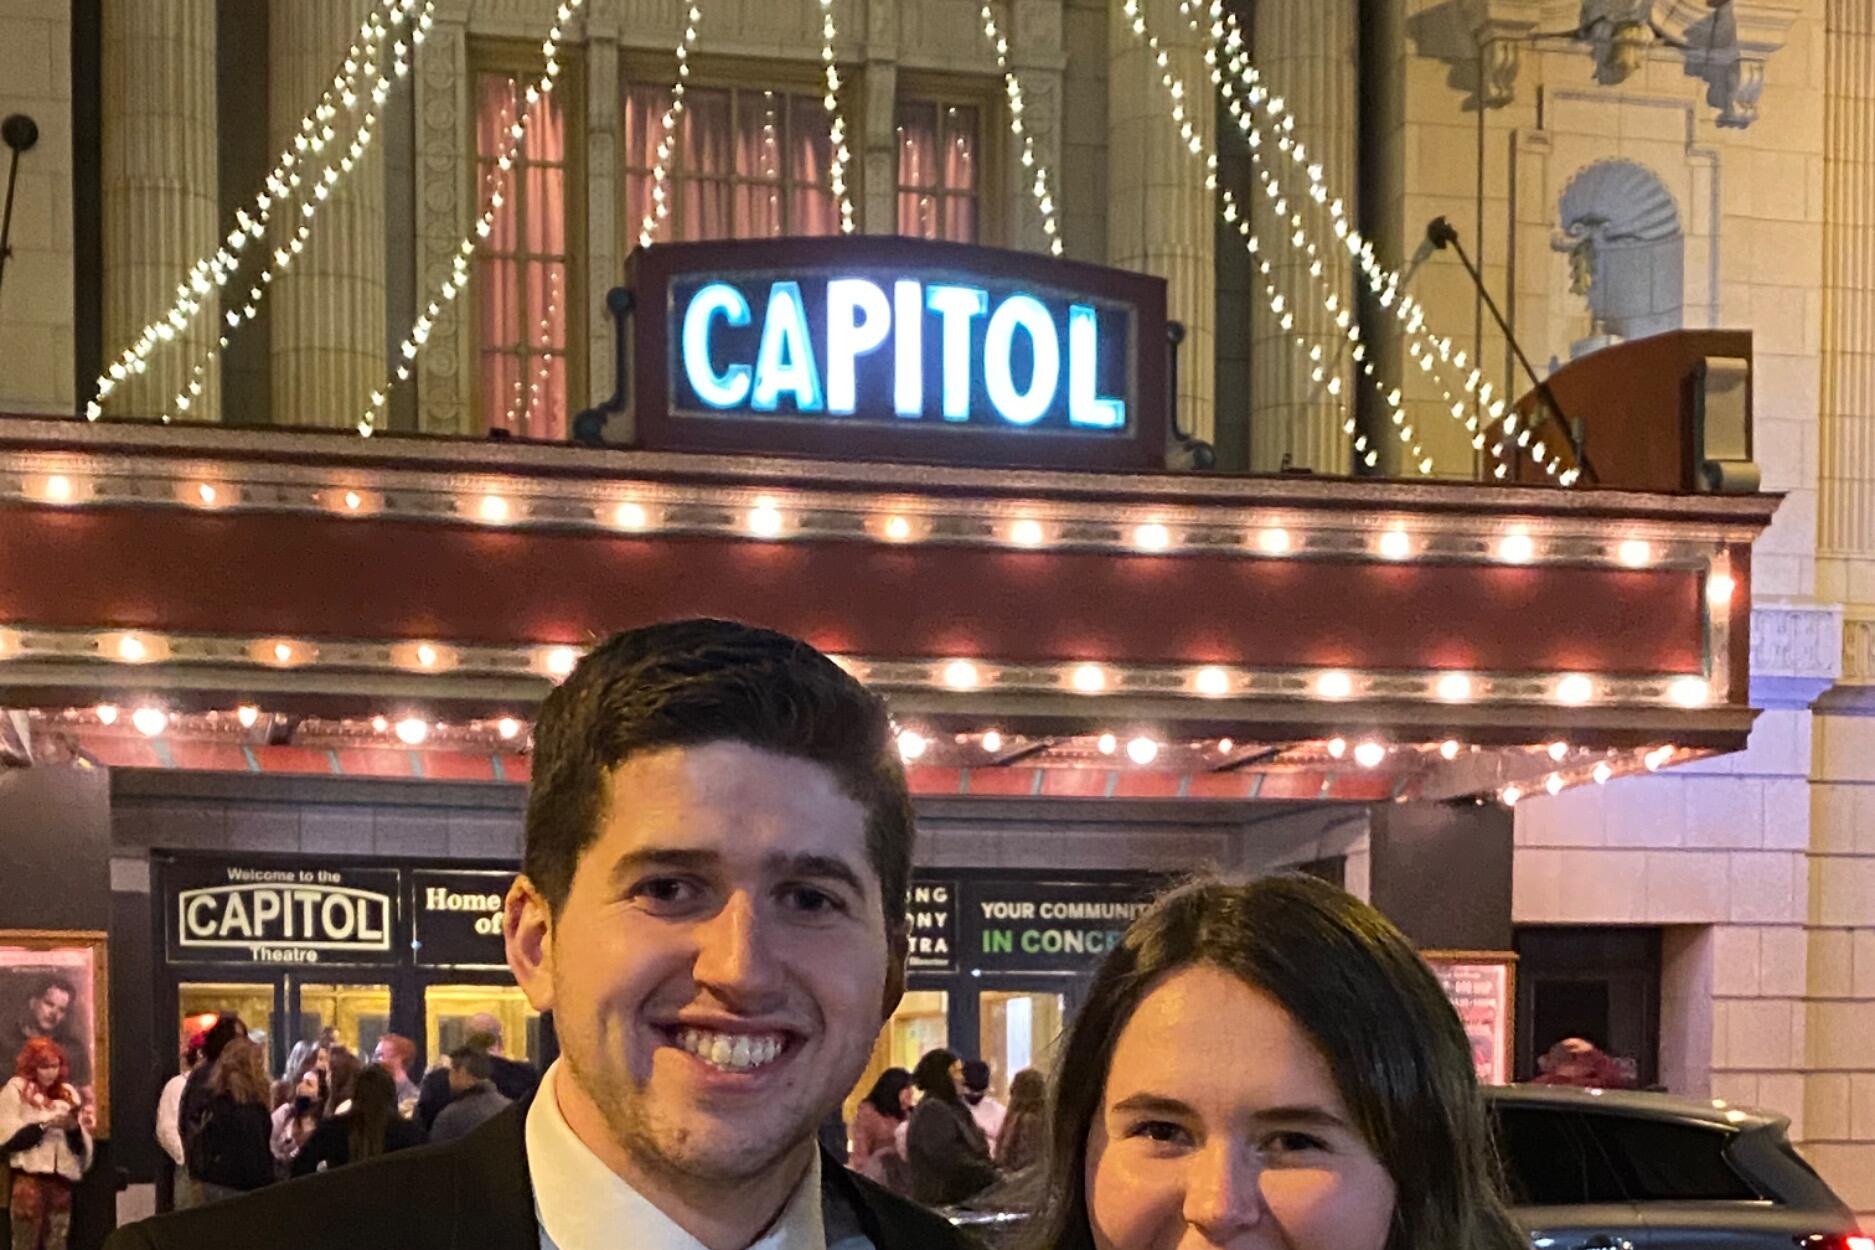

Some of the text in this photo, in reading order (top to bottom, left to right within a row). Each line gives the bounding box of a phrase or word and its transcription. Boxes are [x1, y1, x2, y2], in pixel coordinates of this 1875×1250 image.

[682, 279, 1125, 427] CAPITOL
[227, 867, 341, 883] Welcome to the
[426, 887, 501, 911] Home
[981, 902, 1035, 919] YOUR
[187, 889, 382, 940] CAPITOL
[475, 911, 504, 935] of
[982, 929, 1012, 953] IN
[252, 946, 318, 962] Theatre
